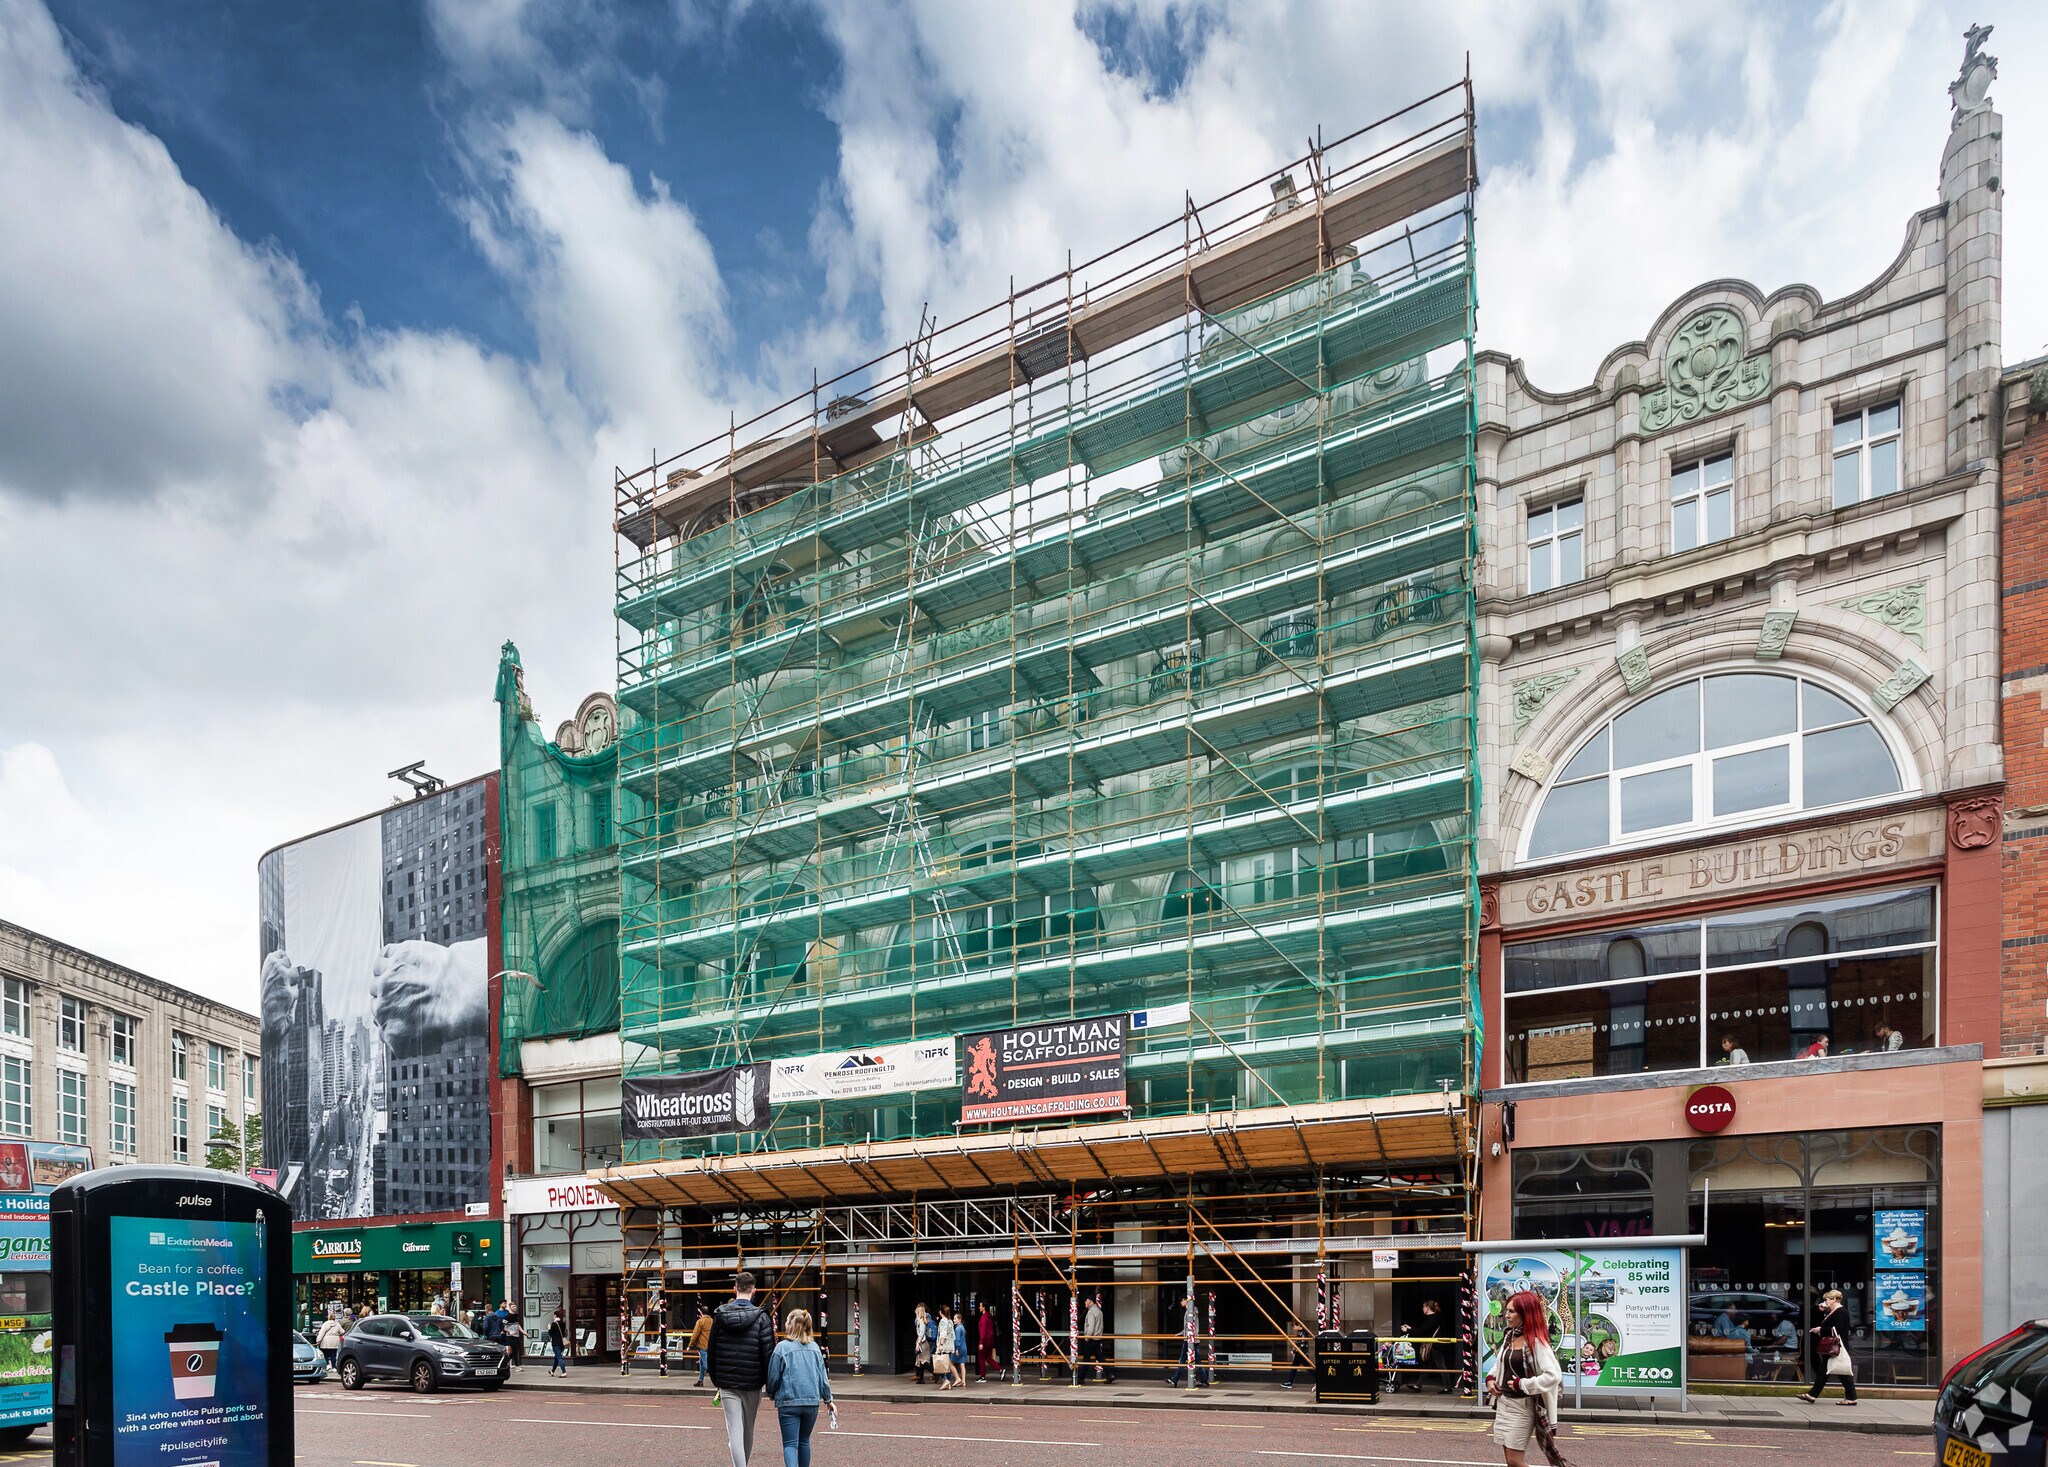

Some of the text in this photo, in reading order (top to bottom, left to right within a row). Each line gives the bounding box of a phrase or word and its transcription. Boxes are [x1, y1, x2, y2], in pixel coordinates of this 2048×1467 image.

[1525, 821, 1906, 914] CASTLE BUILDINGS
[1003, 1019, 1121, 1050] HOUTMAN
[1003, 1037, 1121, 1063] SCAFFOLDING
[824, 1070, 854, 1078] PENROSE
[854, 1066, 883, 1075] ROOFING
[1008, 1068, 1120, 1090] DESIGN BUILD SALES
[635, 1092, 732, 1118] Wheatcross
[966, 1096, 1121, 1120] WWW.HOUTMANSCAFFOLDING.CO.UK
[1690, 1103, 1732, 1114] COSTA
[637, 1119, 677, 1128] CONSTRUCTION
[681, 1116, 701, 1126] FIT-OUT
[702, 1114, 732, 1124] SOLUTIONS
[167, 1236, 233, 1248] ExterionMedia
[313, 1239, 362, 1255] CARROLL'S
[403, 1242, 430, 1252] Giftware
[138, 1263, 244, 1275] Bean for a coffee
[1602, 1259, 1670, 1270] Celebrating
[1627, 1271, 1670, 1281] 85 wild
[125, 1280, 255, 1296] Castle Place?
[1638, 1285, 1670, 1295] years
[1611, 1366, 1674, 1380] THE ZOO
[126, 1404, 257, 1422] 3in4 who notice Pulse perk up
[118, 1424, 139, 1433] with
[149, 1420, 178, 1430] coffee
[180, 1418, 204, 1427] when
[205, 1417, 221, 1425] out
[222, 1415, 238, 1423] and
[240, 1412, 264, 1421] about
[160, 1437, 228, 1452] #pulsecitylife
